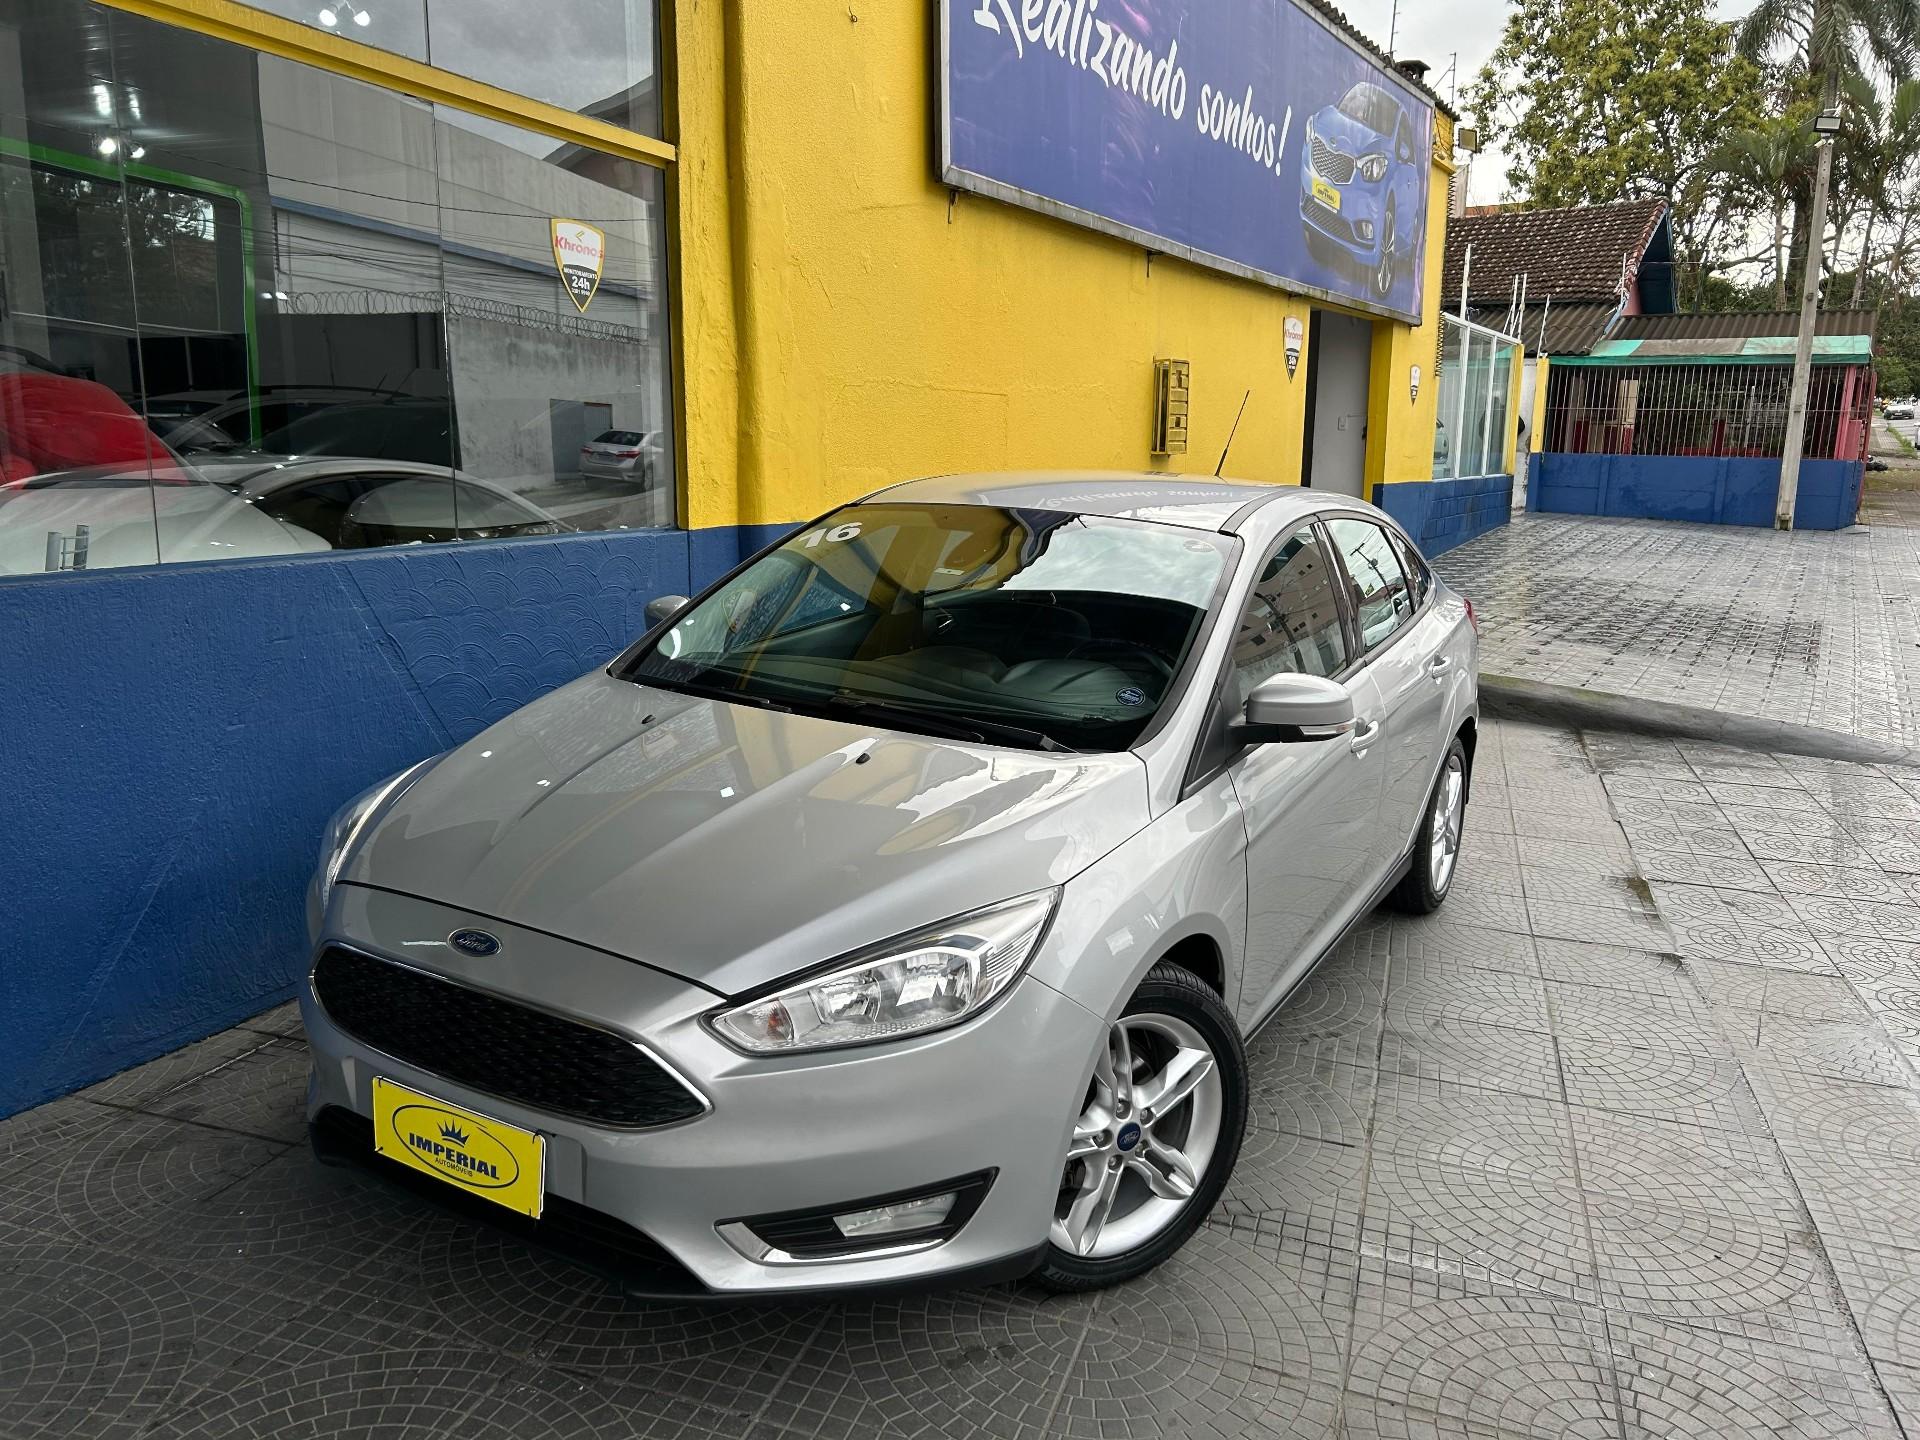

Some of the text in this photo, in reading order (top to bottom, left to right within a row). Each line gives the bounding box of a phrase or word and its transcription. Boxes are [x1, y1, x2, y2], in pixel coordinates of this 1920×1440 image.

[1197, 83, 1292, 177] sonhos!
[555, 235, 603, 258] Khronos
[571, 275, 590, 291] 24h
[798, 522, 863, 549] 16
[409, 1132, 500, 1181] IMPERIAL
